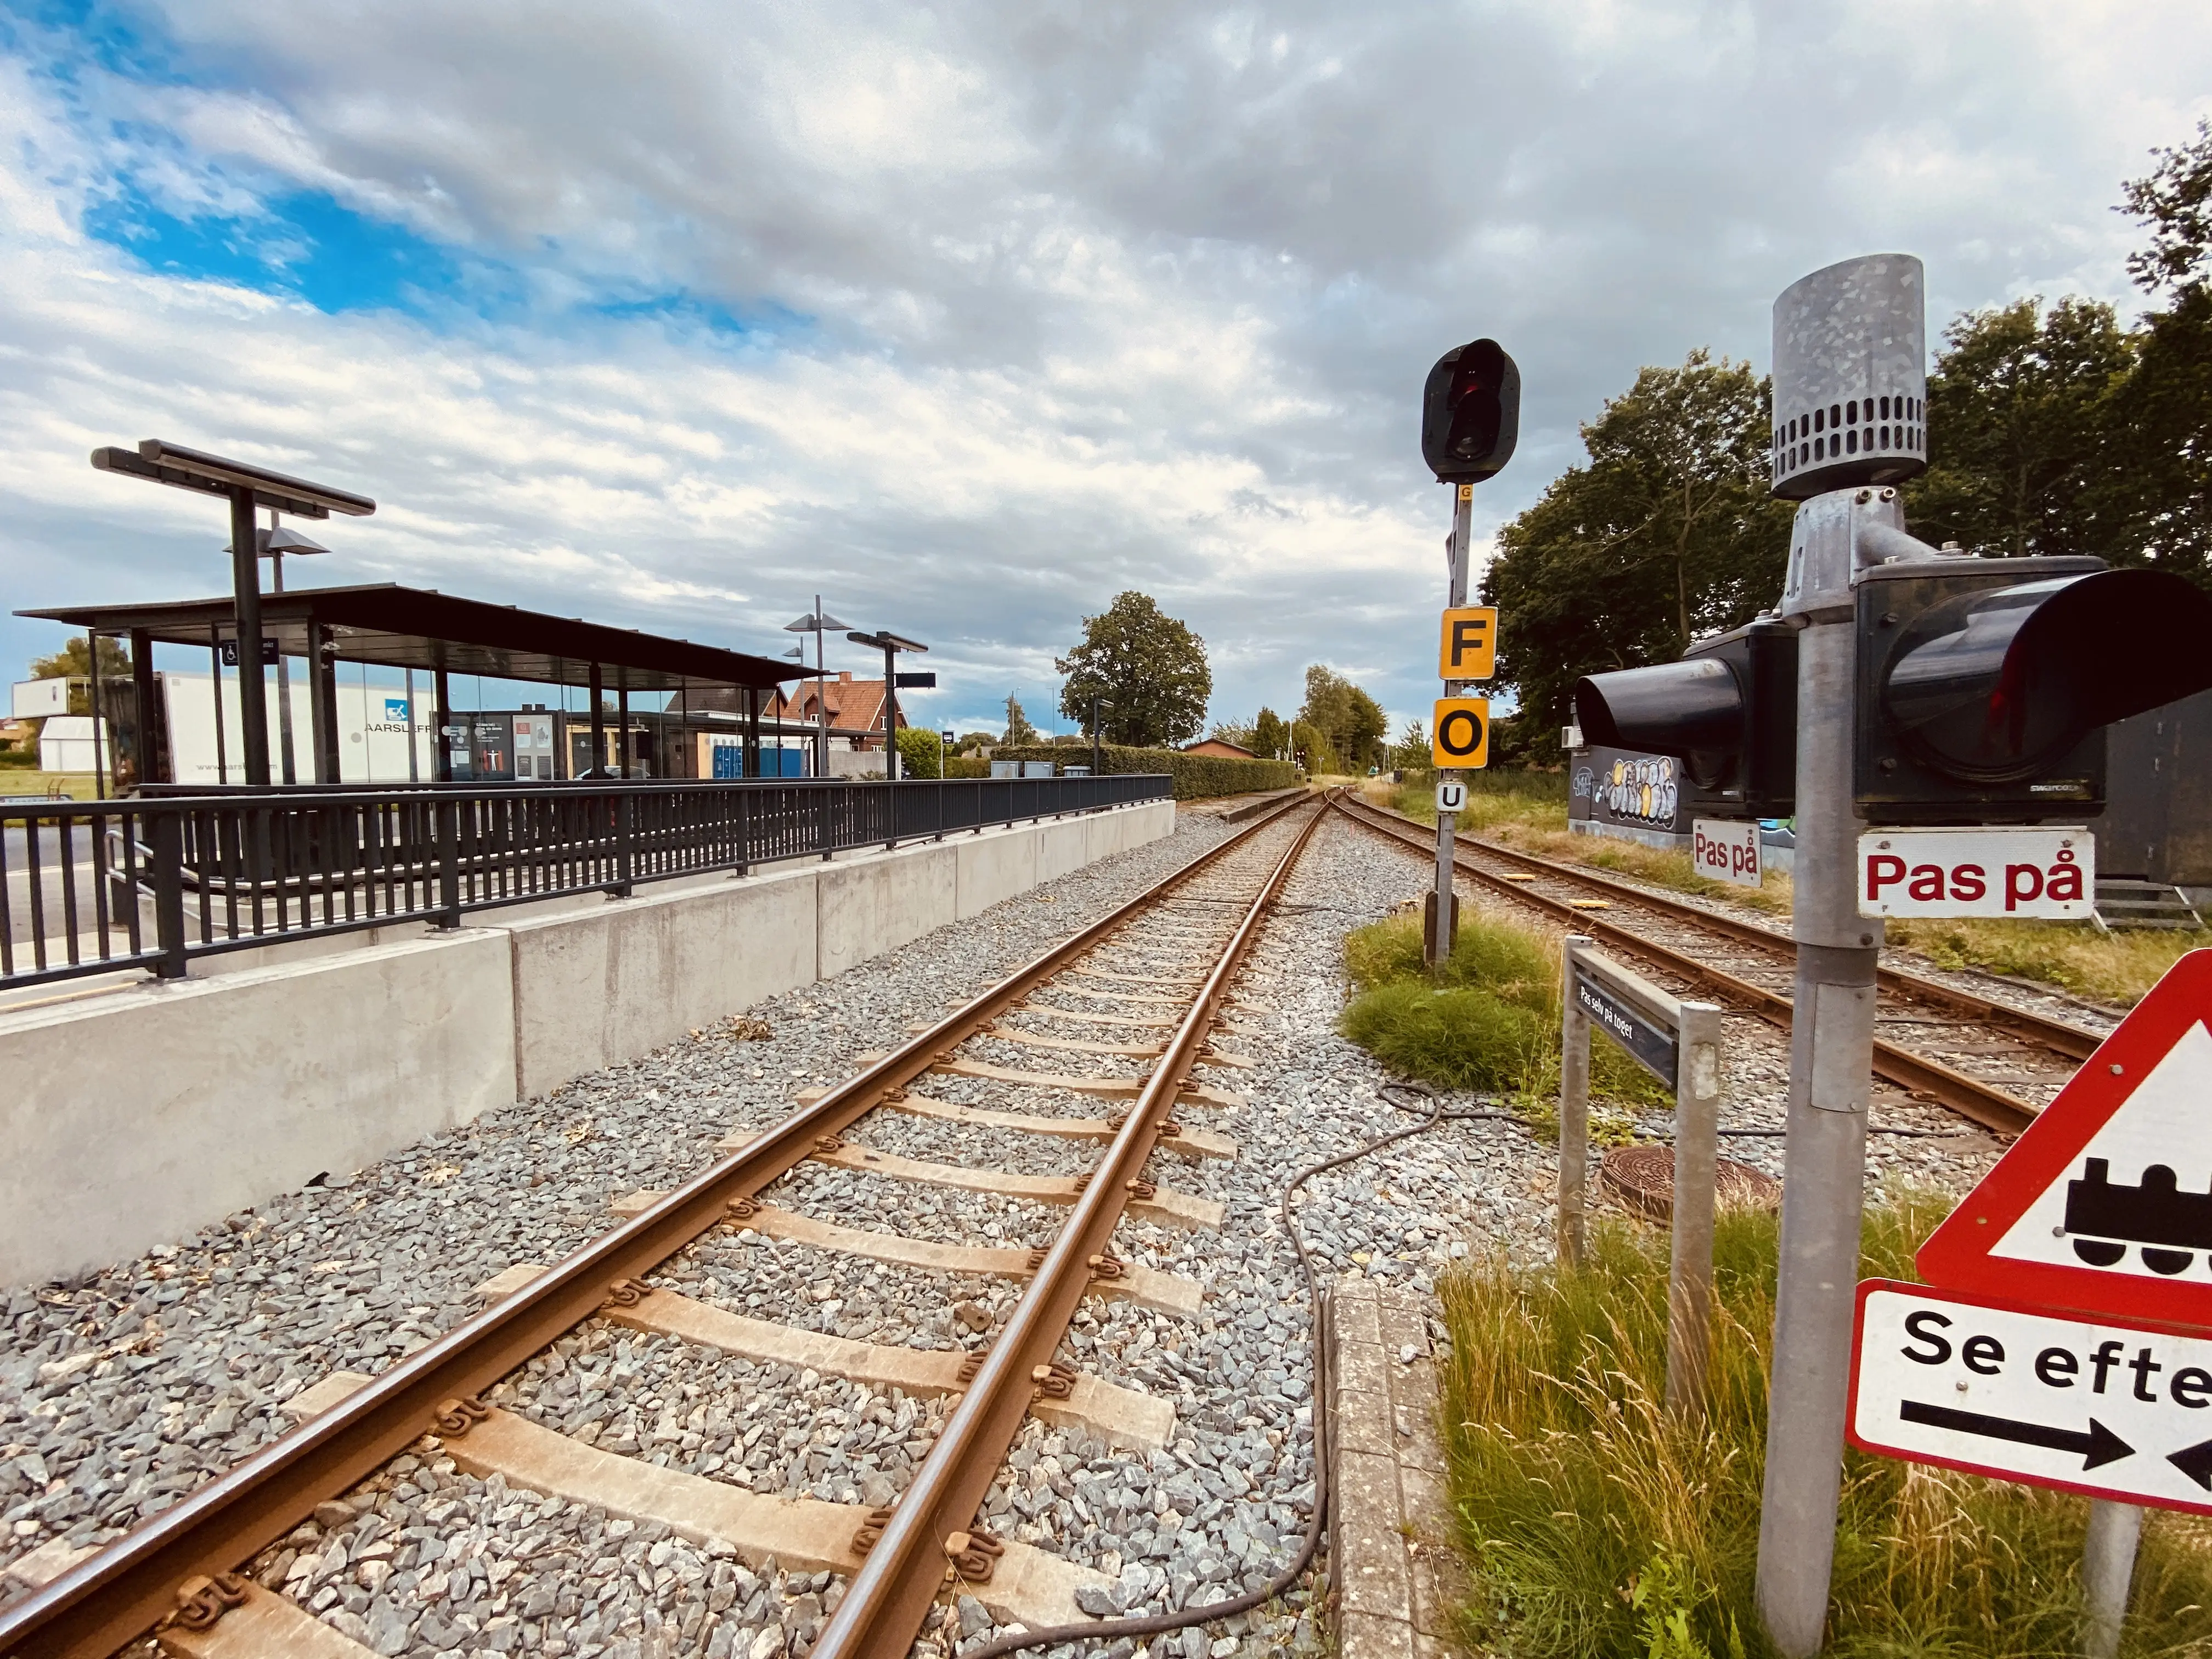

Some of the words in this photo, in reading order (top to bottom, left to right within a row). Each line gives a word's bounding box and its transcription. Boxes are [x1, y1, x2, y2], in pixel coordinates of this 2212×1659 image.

[1462, 487, 1470, 497] G
[1451, 620, 1486, 666] F
[364, 724, 431, 733] AARSLFF
[1438, 709, 1482, 756] O
[1443, 787, 1460, 806] U
[1696, 833, 1728, 868] Pas
[1733, 837, 1757, 877] på
[1867, 855, 1986, 901] Pas
[2005, 849, 2084, 911] på
[1581, 986, 1591, 1006] Pas
[1592, 998, 1604, 1015] selv
[1604, 1006, 1612, 1023] på
[1614, 1013, 1633, 1040] toget
[1900, 1311, 2005, 1375] Se
[2034, 1341, 2212, 1408] efte
